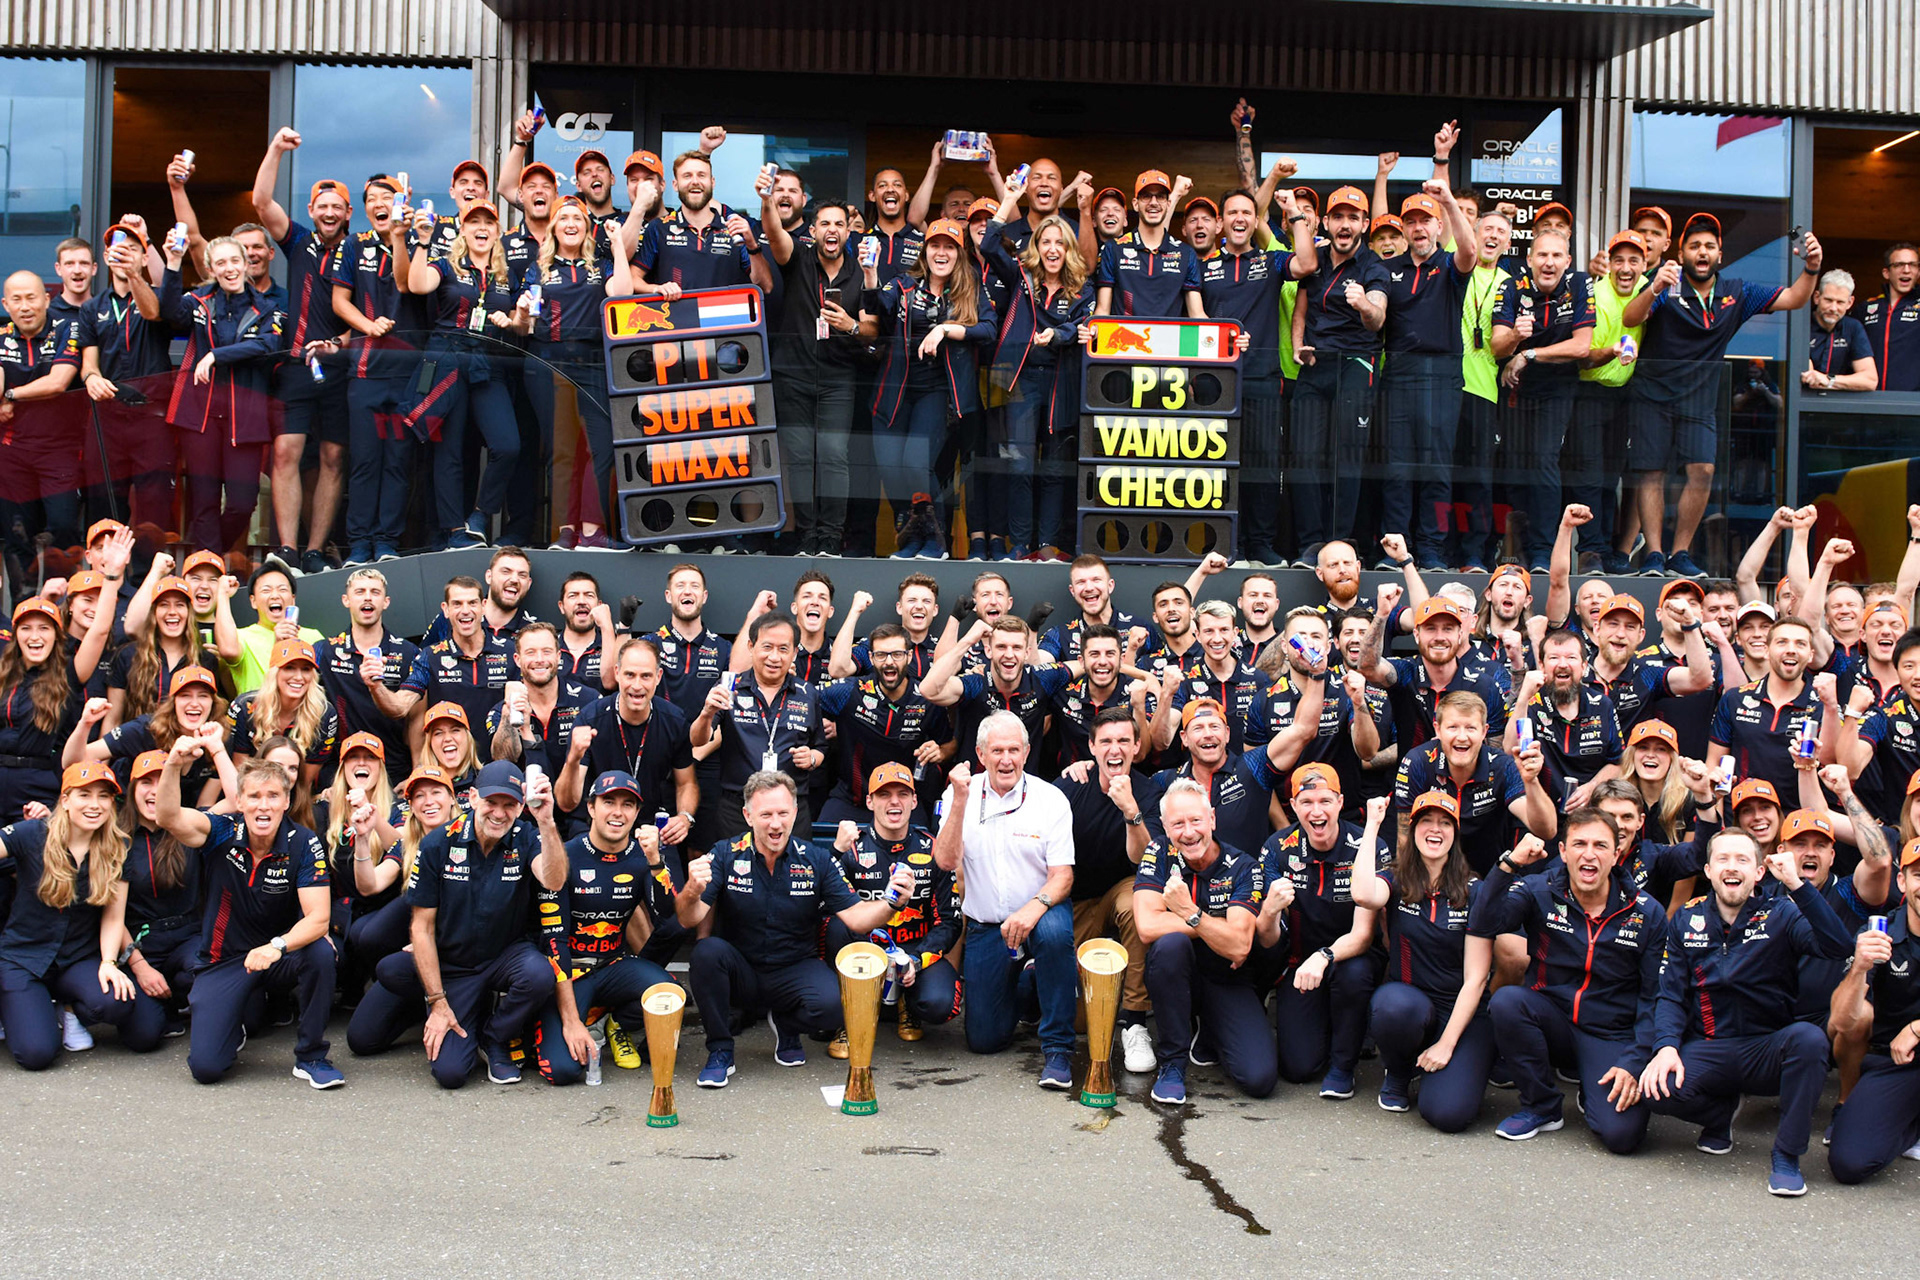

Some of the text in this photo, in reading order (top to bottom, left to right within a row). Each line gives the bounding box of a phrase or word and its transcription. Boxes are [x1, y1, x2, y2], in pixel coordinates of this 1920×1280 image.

[1483, 140, 1558, 153] ORACLE
[1486, 188, 1553, 200] ORACLE
[639, 386, 756, 436] SUPER
[1096, 418, 1227, 459] VAMOS
[652, 435, 750, 484] MAX!
[1098, 467, 1223, 509] CHECO!
[854, 712, 877, 725] ORACLE
[1907, 704, 1919, 721] zoom
[1736, 716, 1760, 724] ORACLE
[1219, 774, 1238, 790] BYBIT
[1219, 783, 1244, 796] HONDA
[236, 822, 244, 840] zoom
[462, 820, 471, 839] zoom
[582, 837, 595, 854] zoom
[445, 865, 462, 873] Mobil
[1283, 870, 1300, 881] Mobil
[443, 873, 469, 881] ORACLE
[728, 875, 747, 885] Mobil
[614, 886, 632, 894] BYBIT
[727, 885, 753, 893] ORACLE
[792, 880, 814, 889] BYBIT
[538, 891, 556, 900] claro
[857, 887, 931, 900] ORLE
[1209, 893, 1231, 903] BYBIT
[1398, 905, 1420, 917] ORACLE
[896, 923, 928, 944] Bull
[1546, 922, 1574, 934] ORACLE
[568, 935, 599, 952] Red
[600, 933, 623, 952] Bull
[1614, 937, 1639, 948] HONDA
